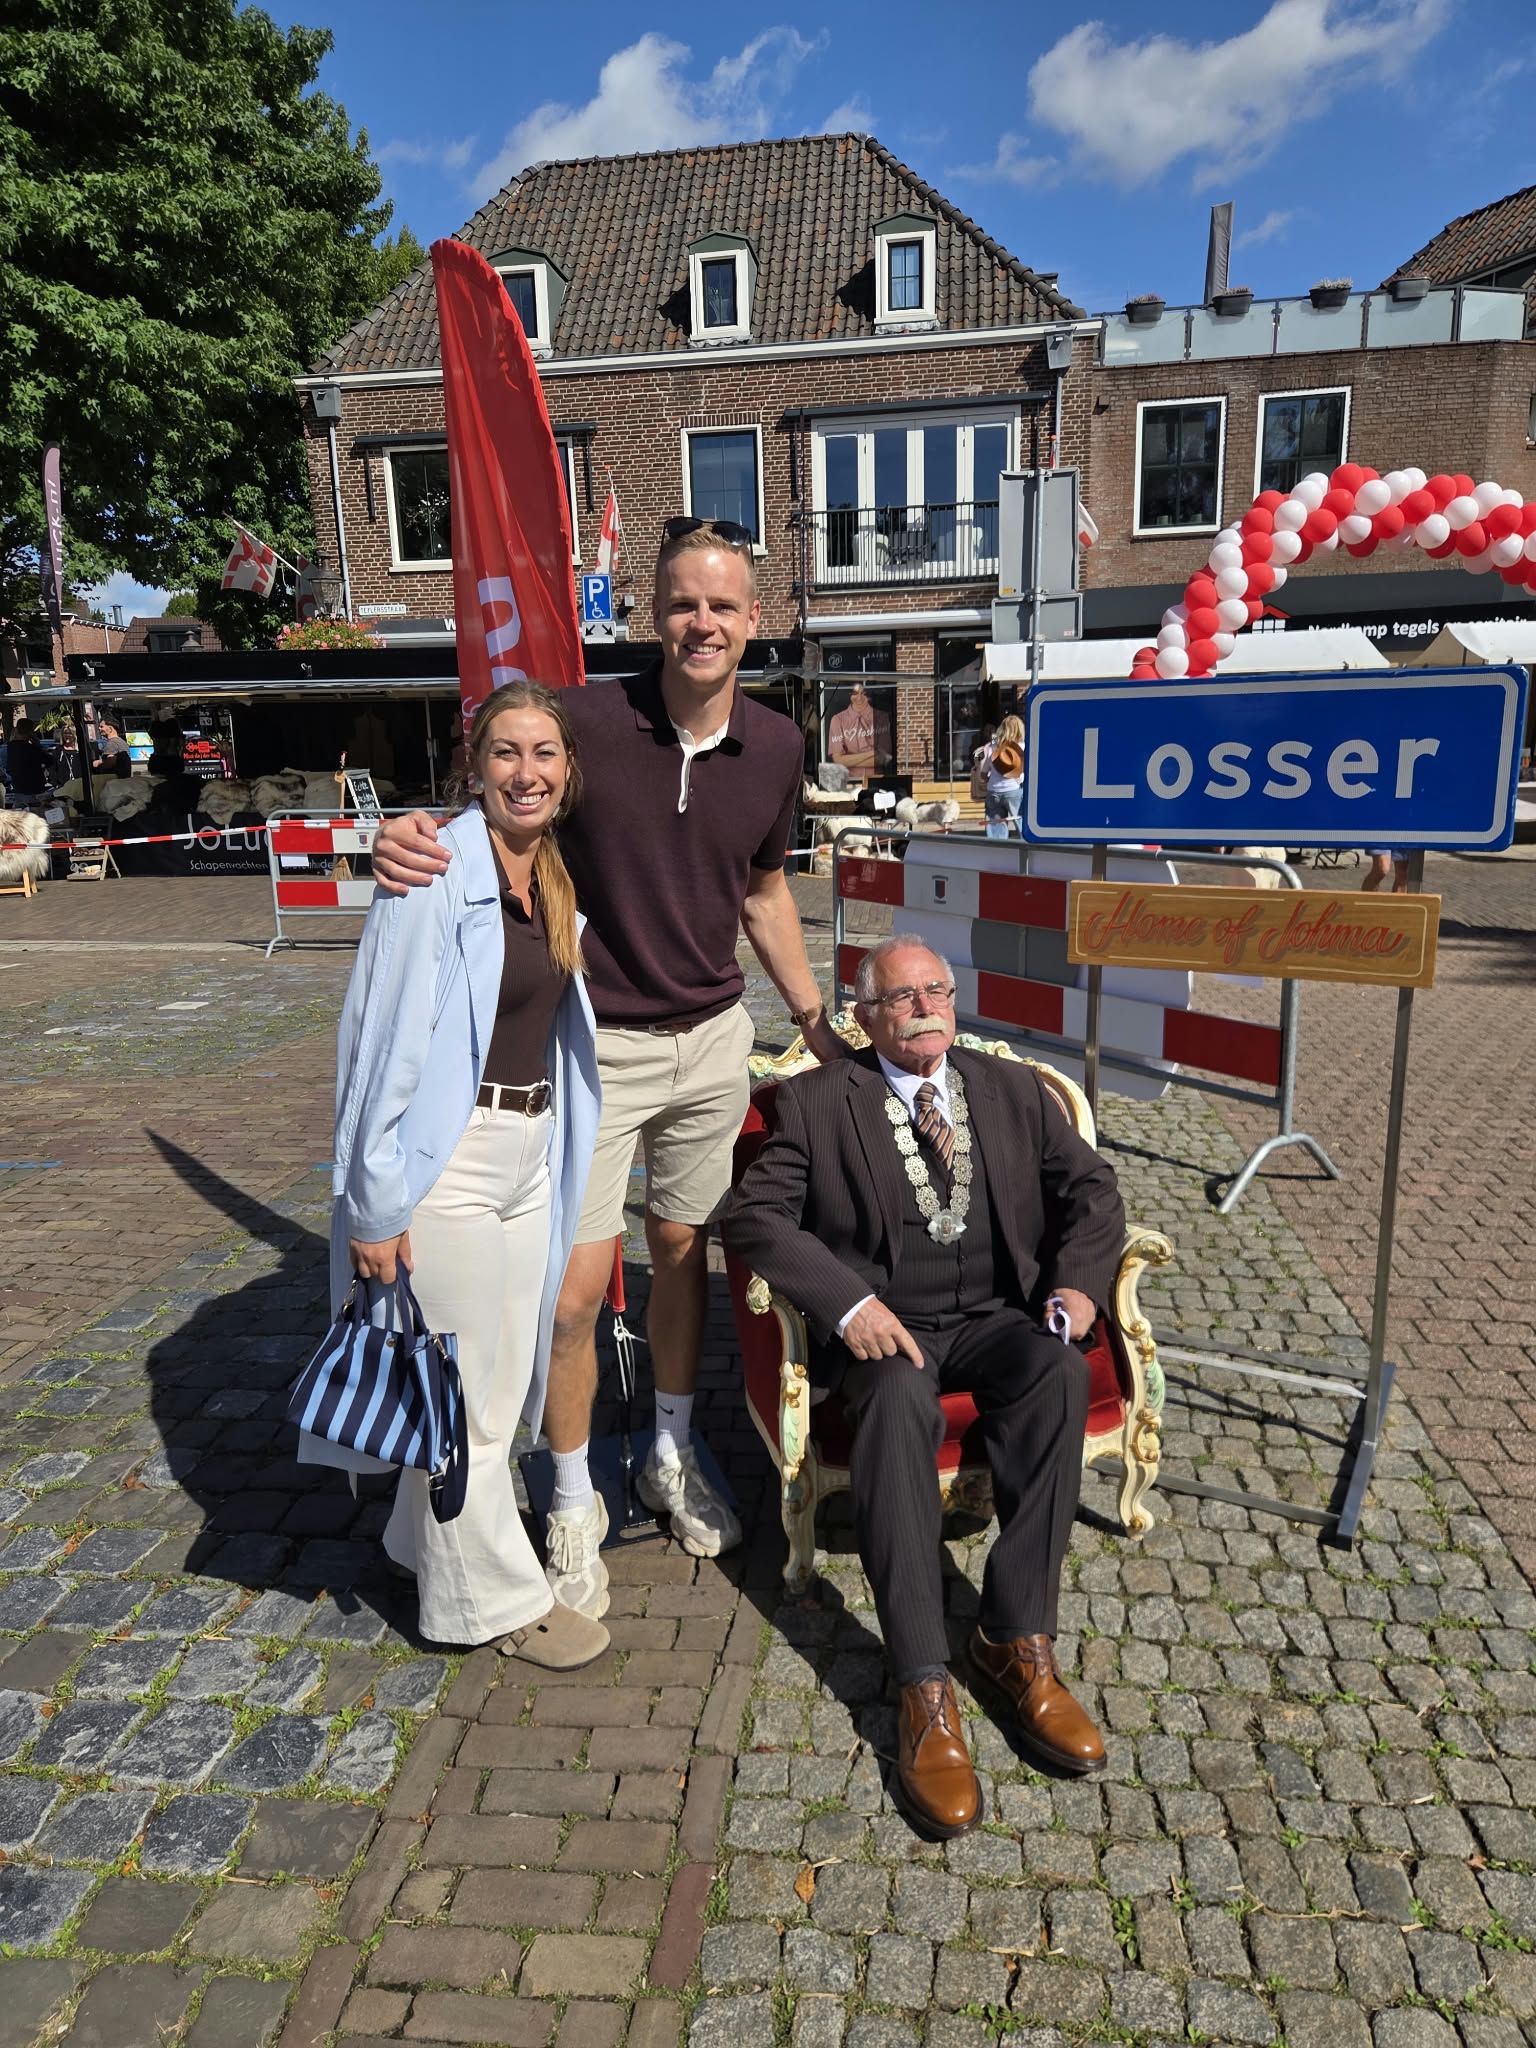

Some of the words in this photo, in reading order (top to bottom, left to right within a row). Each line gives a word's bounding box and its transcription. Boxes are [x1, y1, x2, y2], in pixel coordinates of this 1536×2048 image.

[588, 578, 604, 602] P
[1392, 618, 1440, 638] tegels
[1081, 727, 1441, 800] Losser
[1083, 890, 1206, 950] Home
[1211, 903, 1262, 966] of
[1257, 899, 1405, 963] Johma
